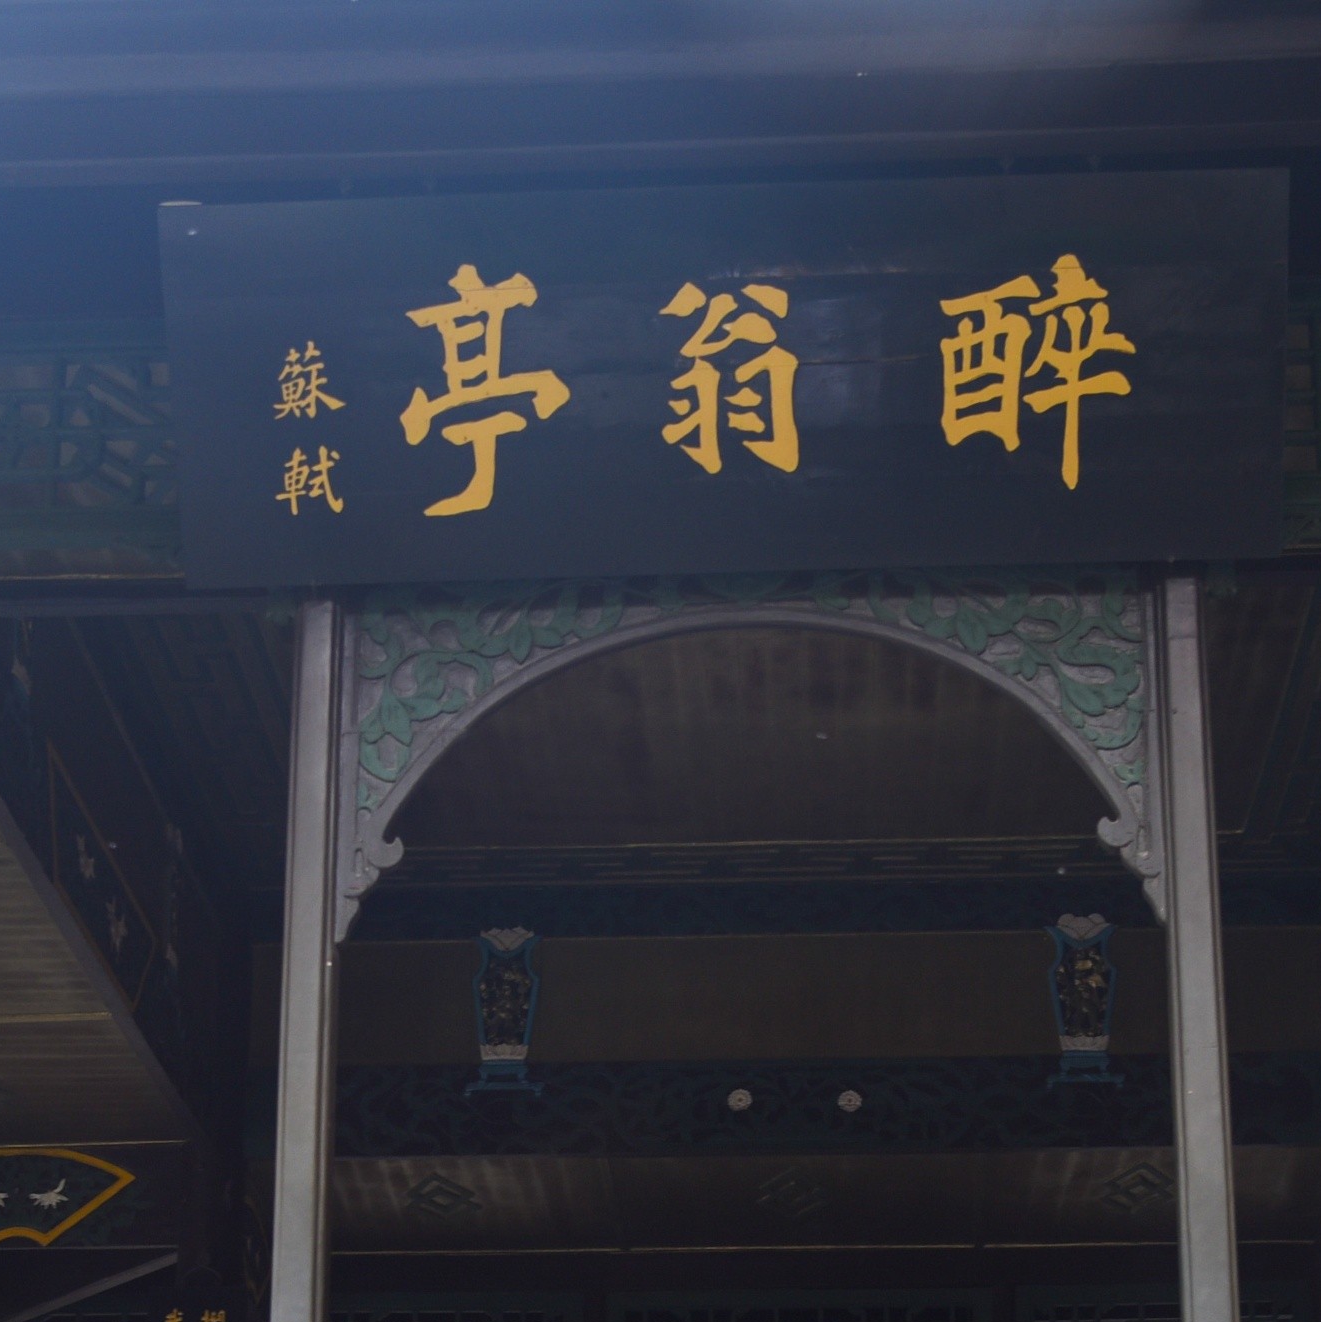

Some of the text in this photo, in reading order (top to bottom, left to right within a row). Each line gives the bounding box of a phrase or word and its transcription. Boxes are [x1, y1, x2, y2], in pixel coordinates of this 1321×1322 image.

[272, 341, 346, 516] 蘇軾
[399, 253, 1137, 518] 醉翁亭
